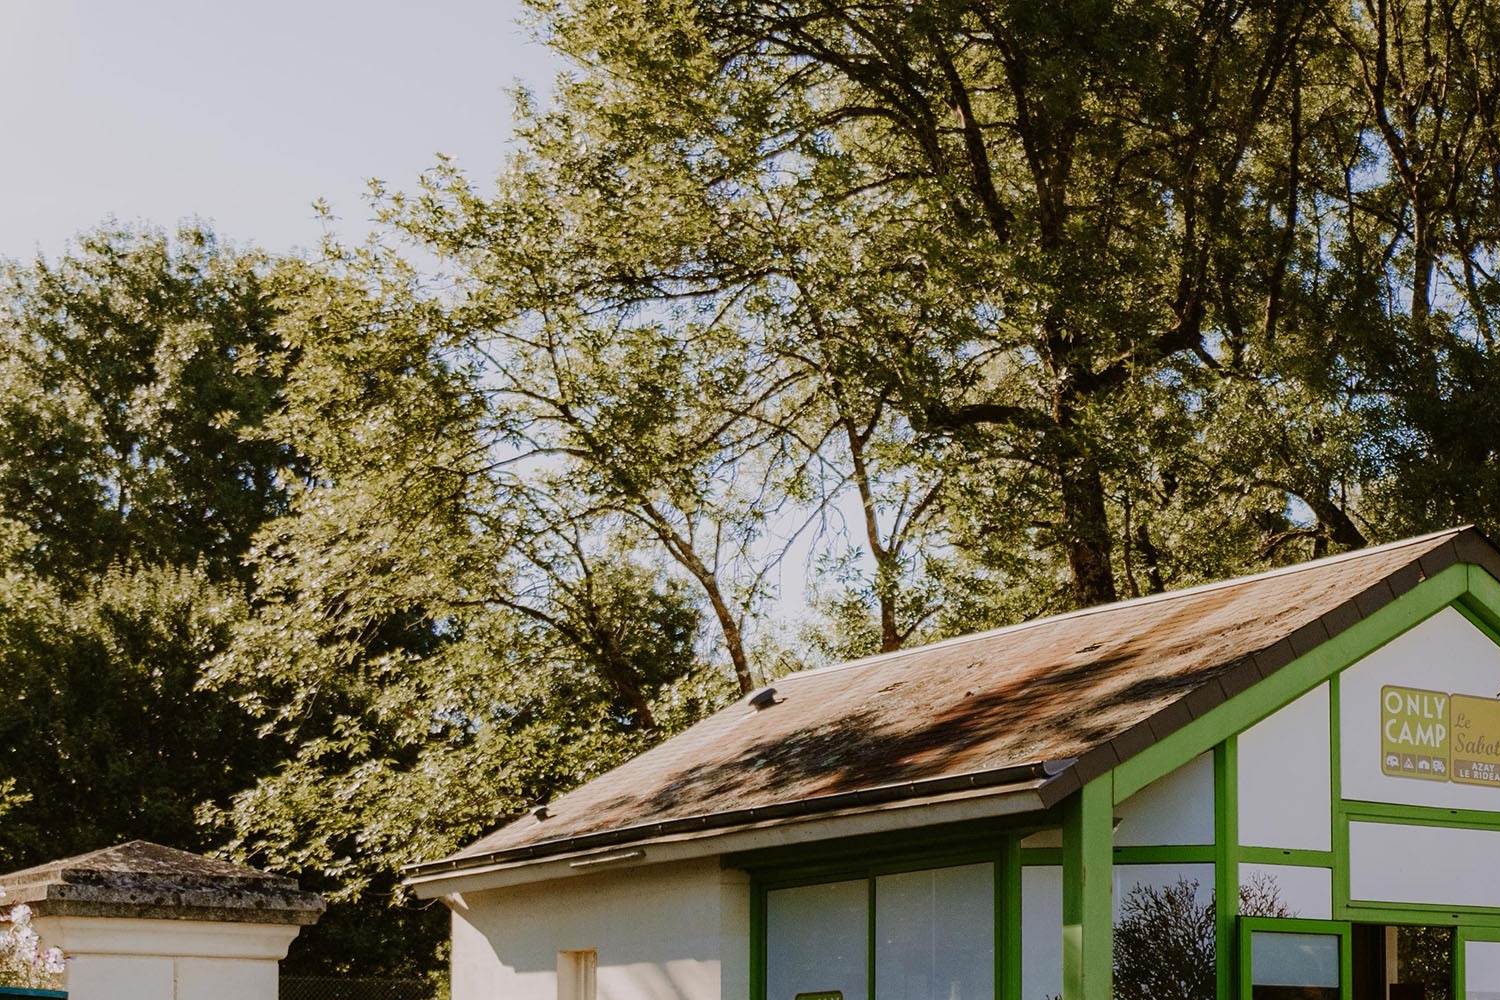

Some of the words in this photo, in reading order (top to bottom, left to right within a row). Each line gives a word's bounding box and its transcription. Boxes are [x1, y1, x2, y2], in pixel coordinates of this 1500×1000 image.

[1385, 692, 1445, 719] ONLY
[1455, 713, 1471, 728] Le
[1385, 719, 1445, 748] CAMP
[1455, 733, 1500, 756] Sabot
[1460, 770, 1470, 778] LE
[1472, 763, 1495, 771] AZAY
